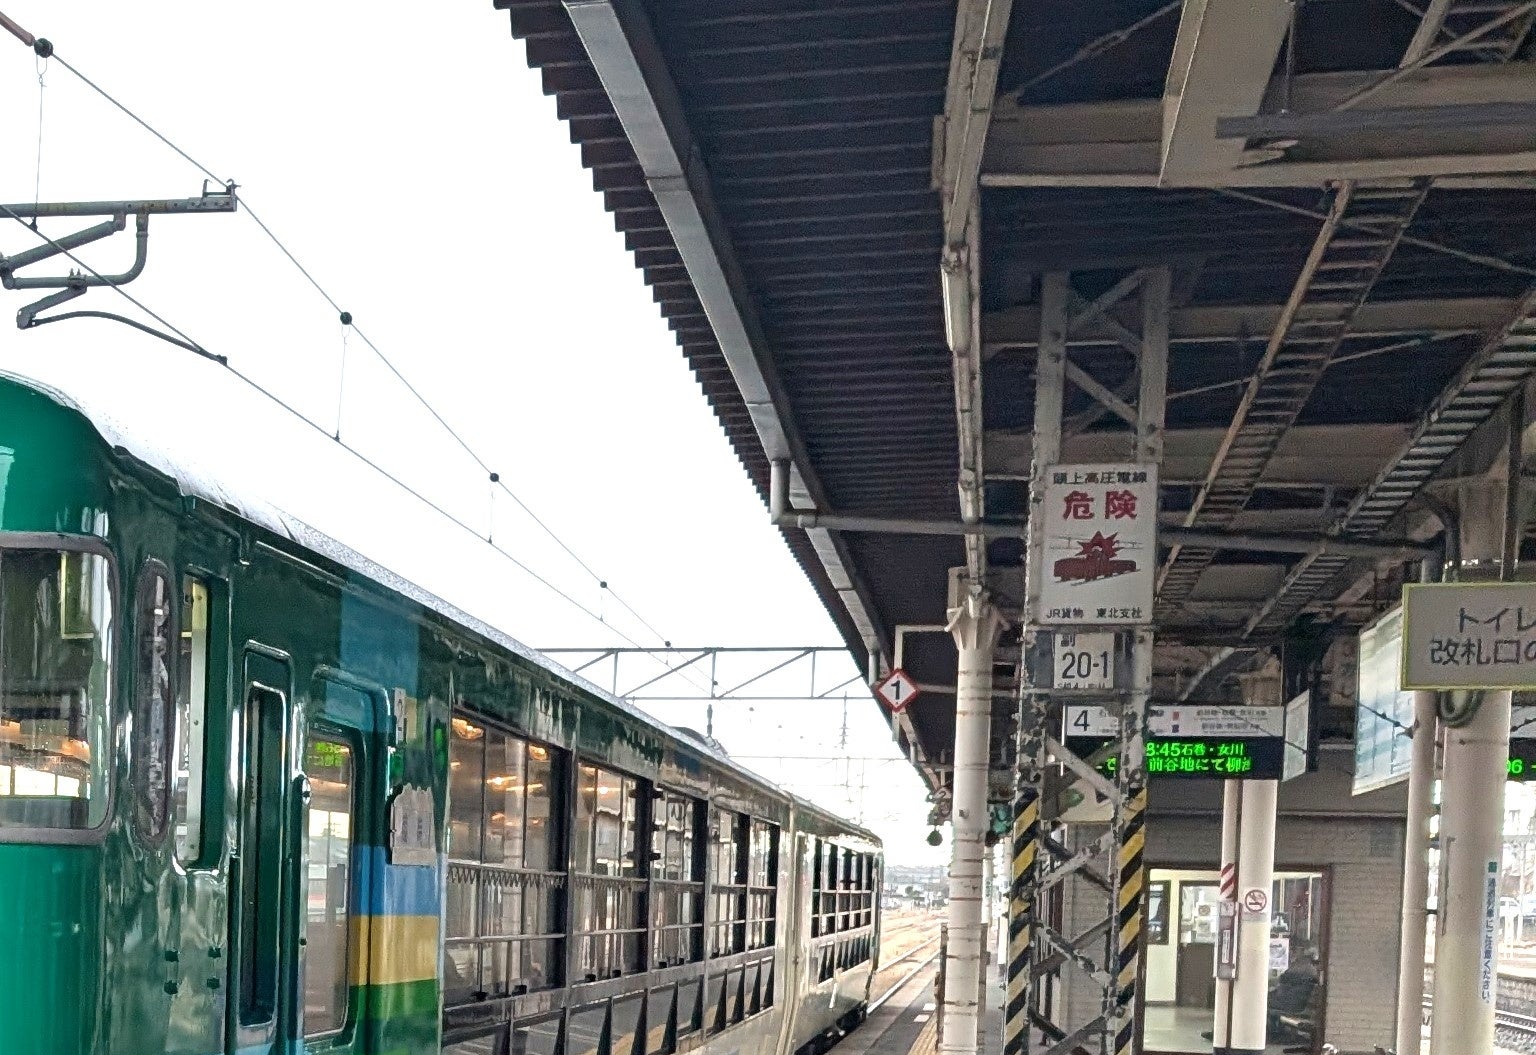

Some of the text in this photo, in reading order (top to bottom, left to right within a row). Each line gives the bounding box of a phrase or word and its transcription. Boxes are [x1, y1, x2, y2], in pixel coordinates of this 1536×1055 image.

[1062, 489, 1138, 520] 危険
[1458, 607, 1536, 634] トイレ
[1061, 650, 1108, 679] 20-1
[891, 680, 901, 700] 1
[1073, 709, 1090, 732] 4
